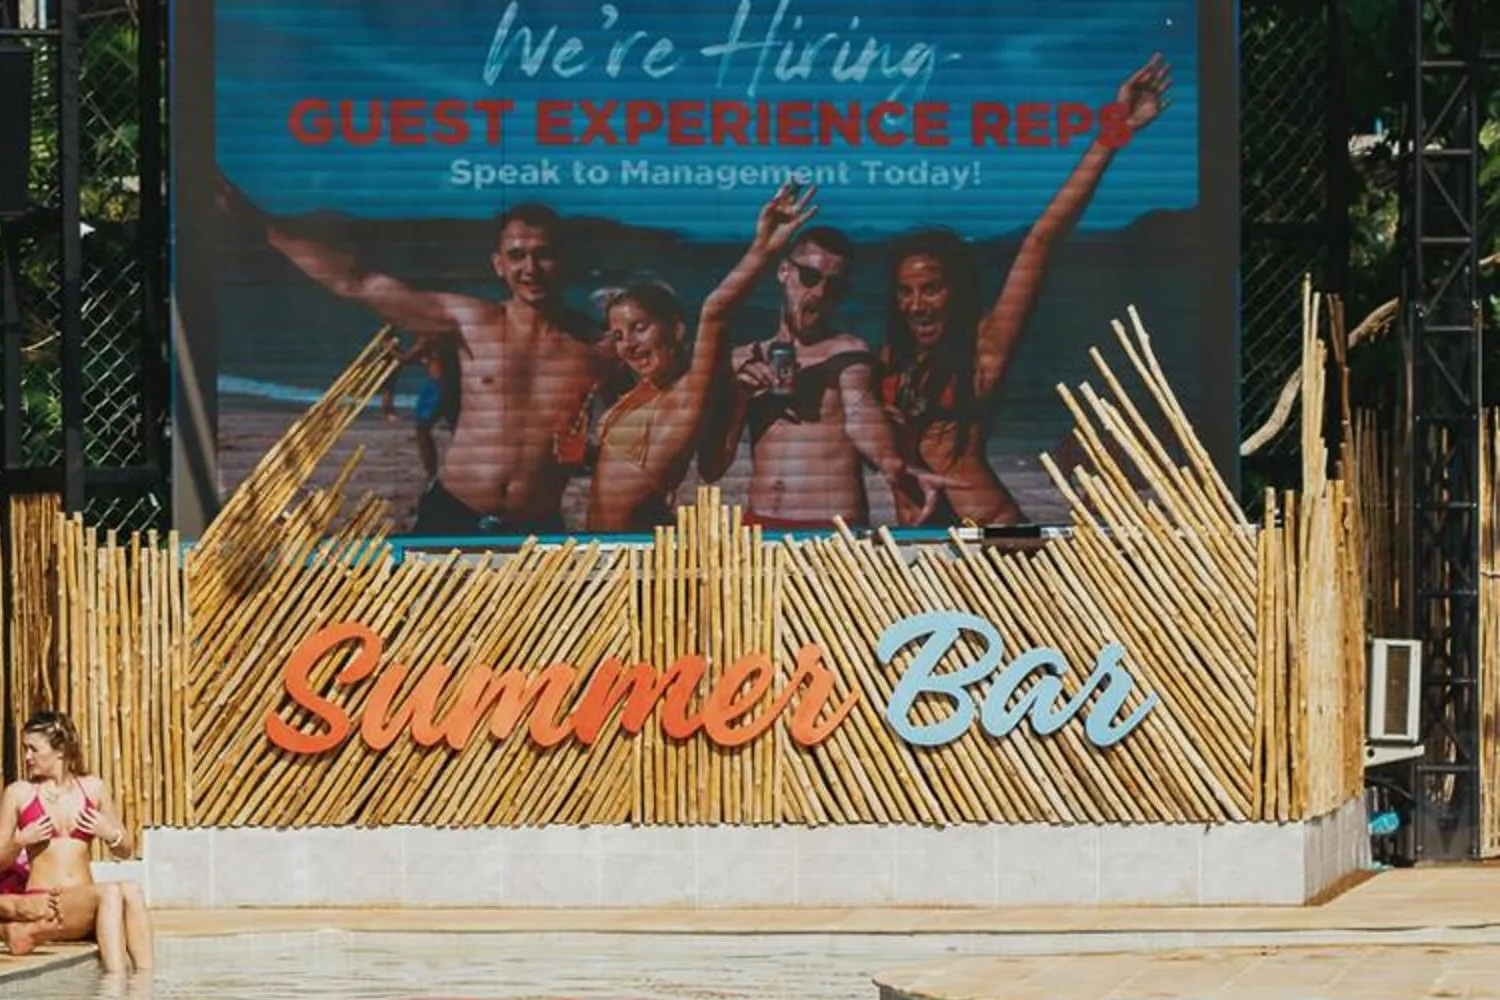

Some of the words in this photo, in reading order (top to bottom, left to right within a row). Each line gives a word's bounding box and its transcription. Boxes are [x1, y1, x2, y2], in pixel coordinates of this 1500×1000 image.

[484, 0, 688, 86] We're
[701, 0, 961, 125] Hiring
[287, 98, 514, 146] GUEST
[535, 100, 951, 148] EXPERIENCE
[971, 101, 1134, 148] REPS
[450, 159, 561, 190] Speak
[573, 162, 609, 185] to
[621, 160, 850, 190] Management
[861, 161, 982, 187] Today!
[264, 620, 861, 754] Summer
[874, 607, 1160, 748] Bar
